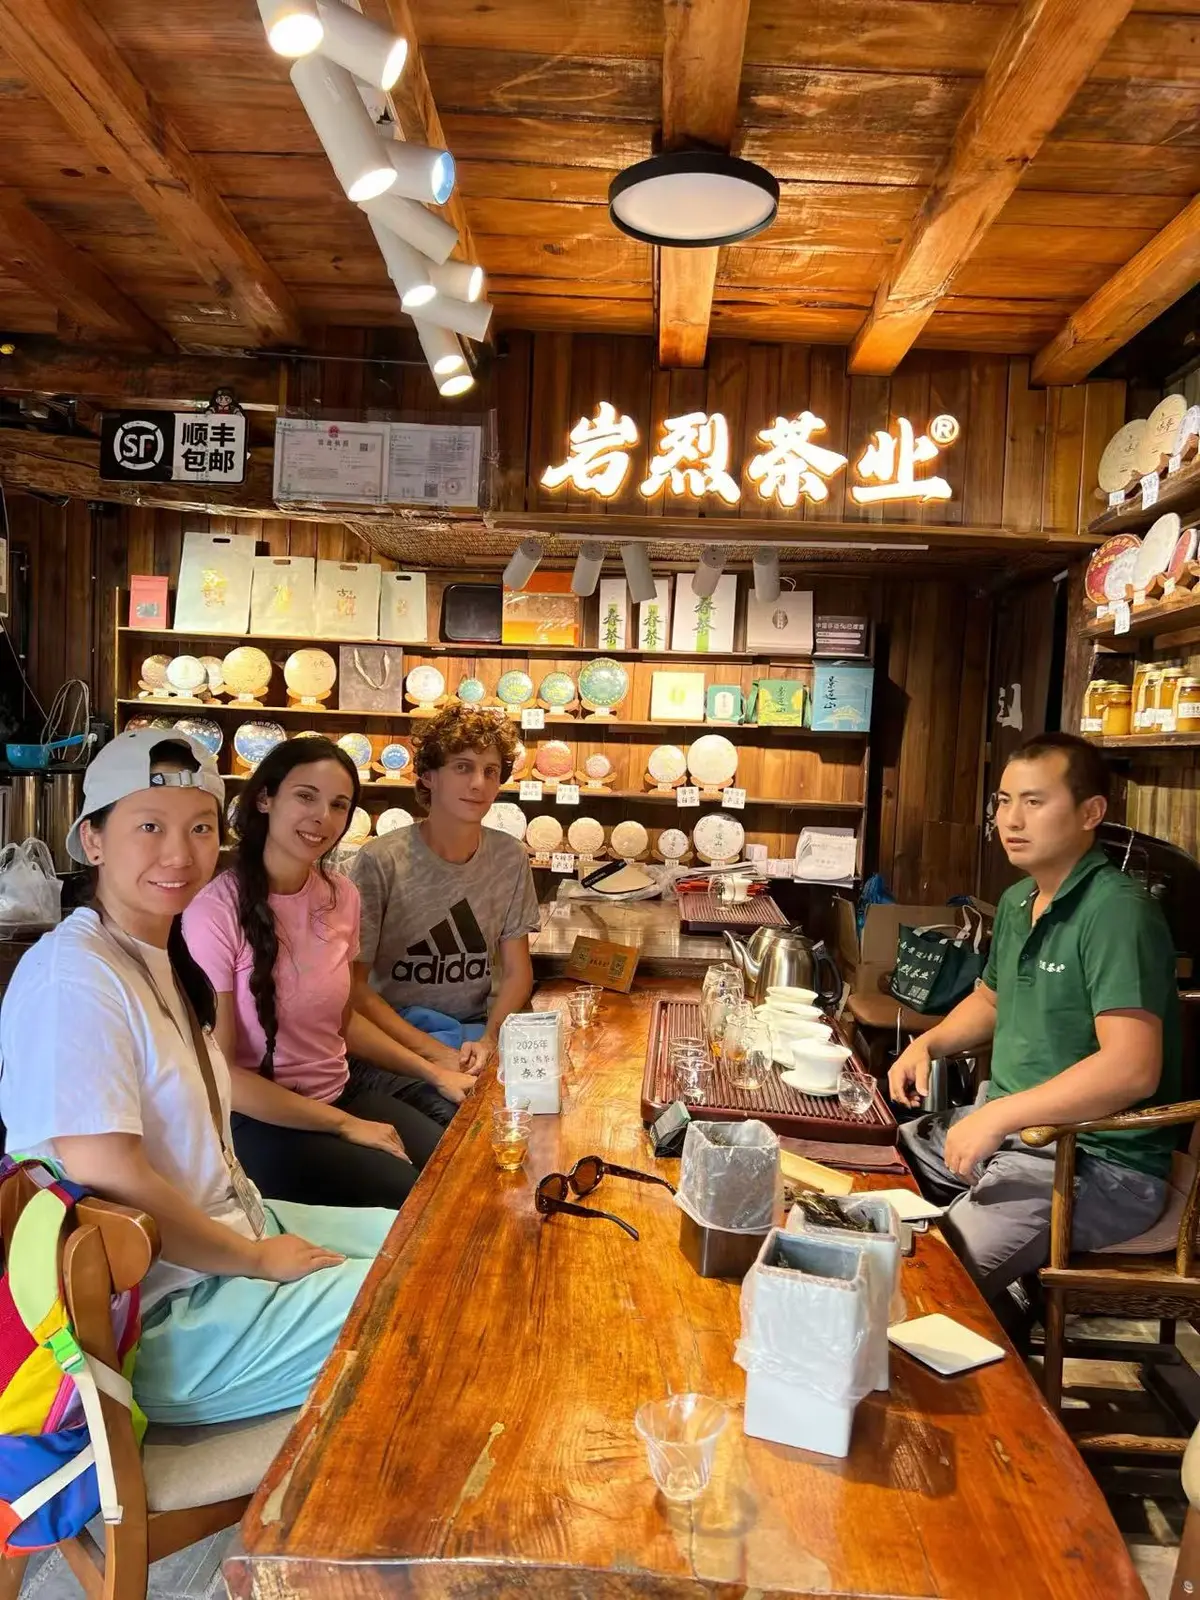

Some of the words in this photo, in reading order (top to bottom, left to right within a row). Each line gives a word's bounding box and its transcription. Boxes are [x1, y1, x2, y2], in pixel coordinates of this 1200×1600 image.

[181, 423, 236, 447] 顺丰
[181, 448, 236, 473] 包邮
[540, 400, 953, 507] 岩烈茶业
[602, 608, 623, 645] 春茶
[642, 608, 663, 646] 春茶
[516, 1039, 548, 1051] 2025年
